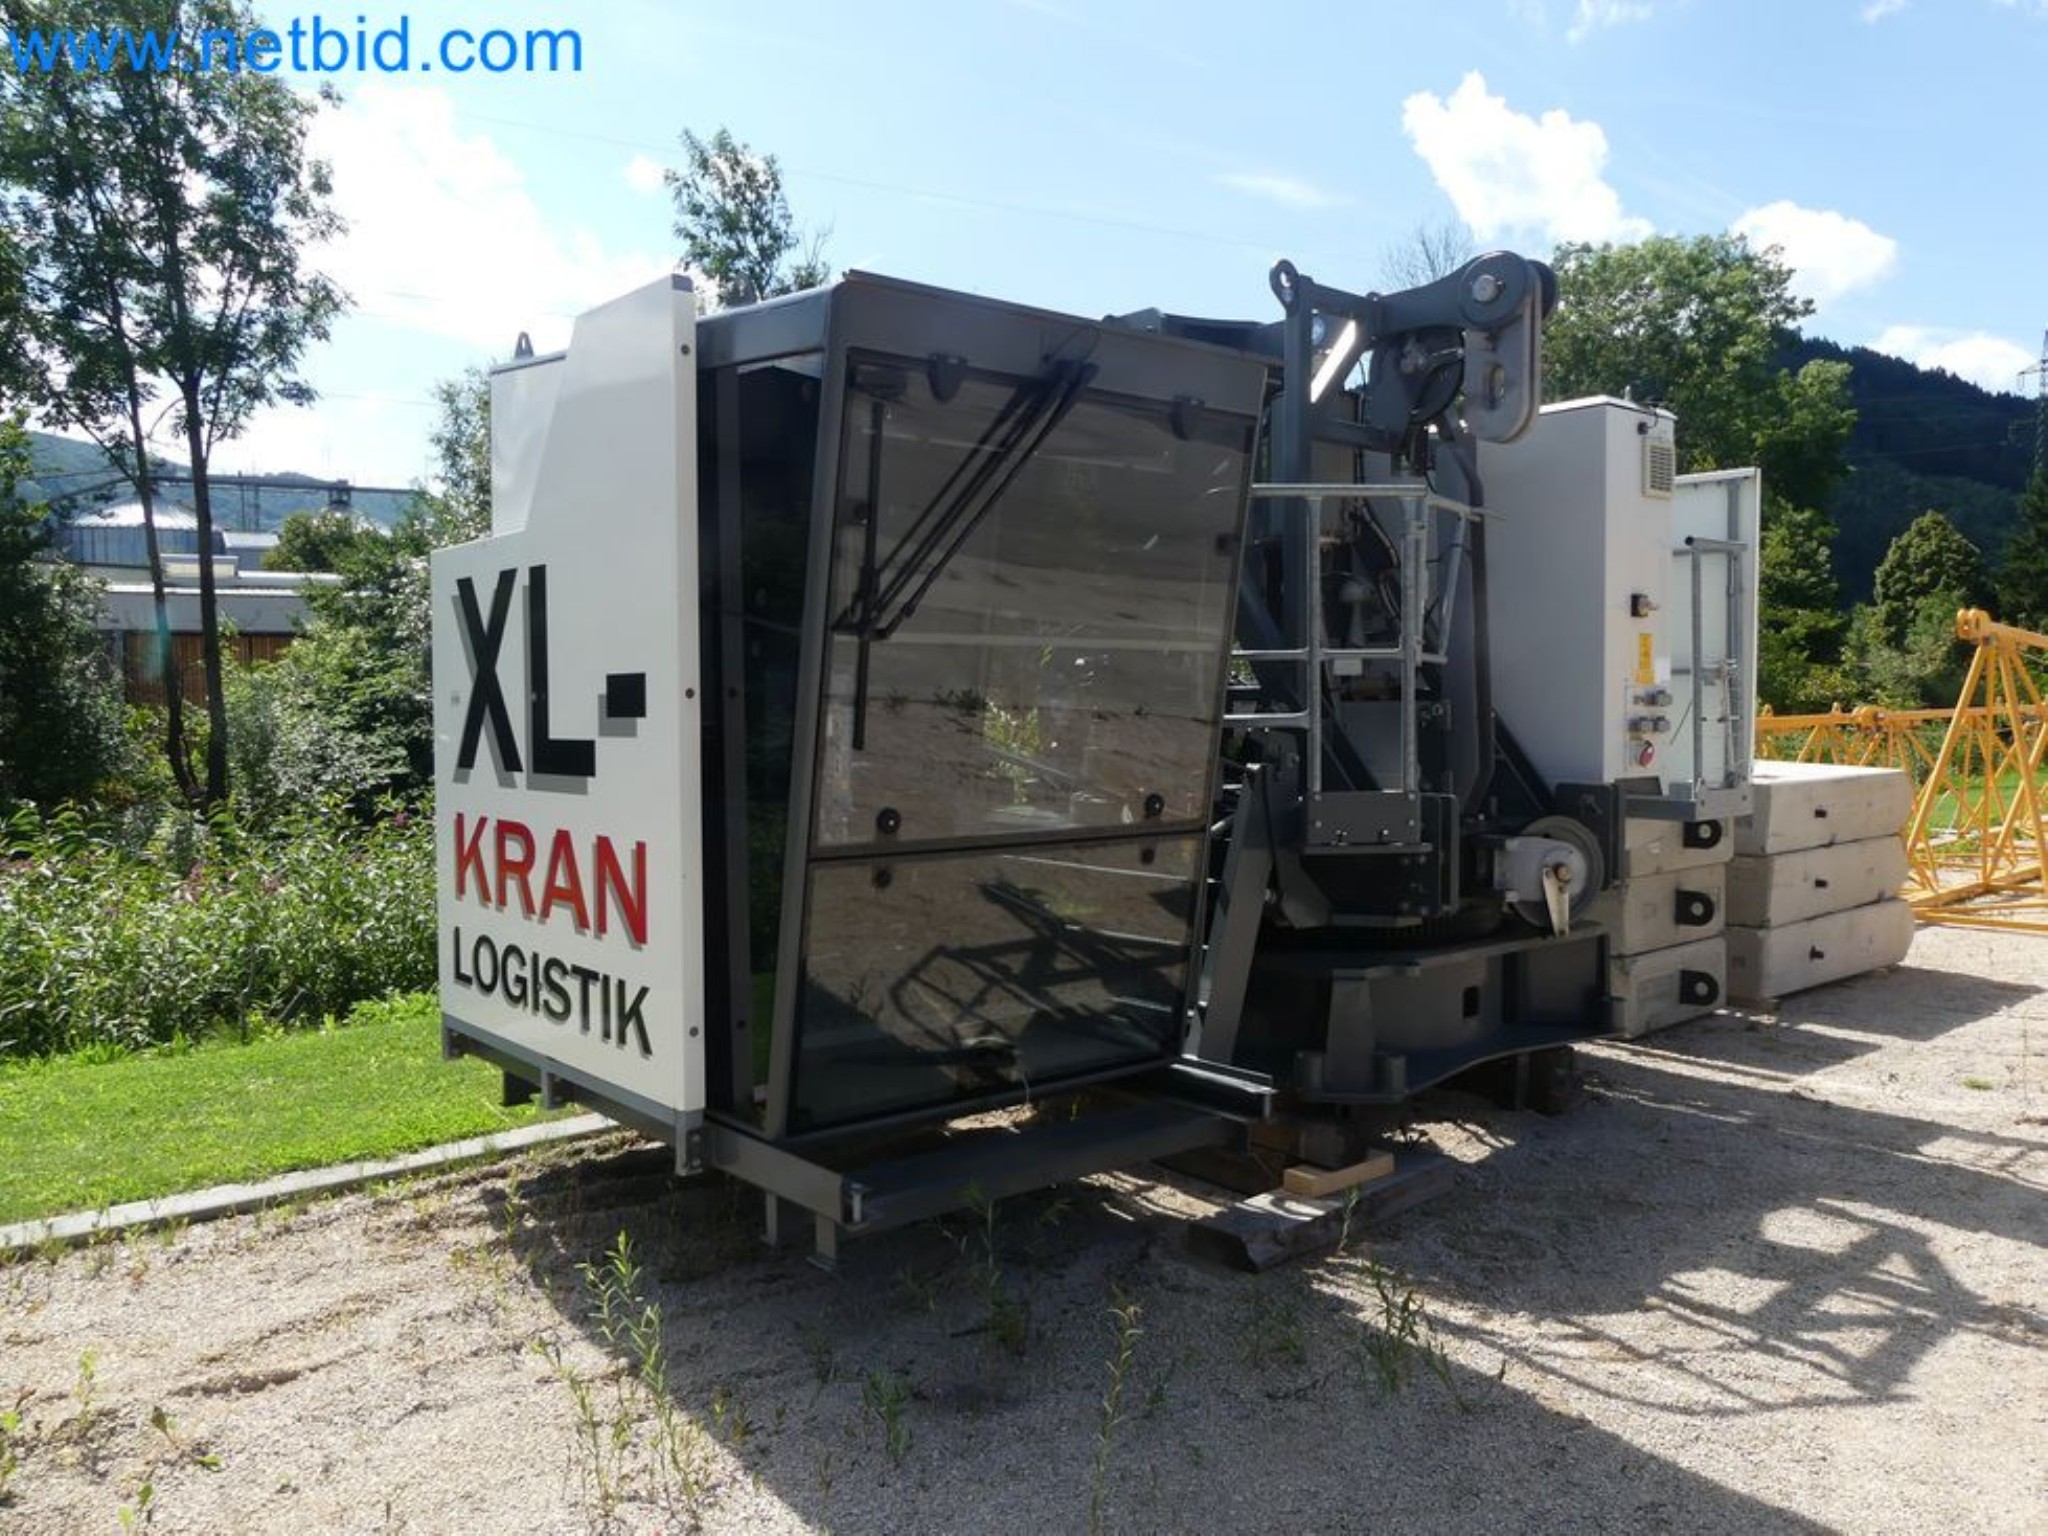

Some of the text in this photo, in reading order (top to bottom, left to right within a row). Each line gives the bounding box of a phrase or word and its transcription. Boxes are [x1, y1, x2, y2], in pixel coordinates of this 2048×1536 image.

[455, 564, 647, 778] XL-
[454, 811, 648, 947] KRAN
[453, 926, 652, 1057] LOGISTIK
